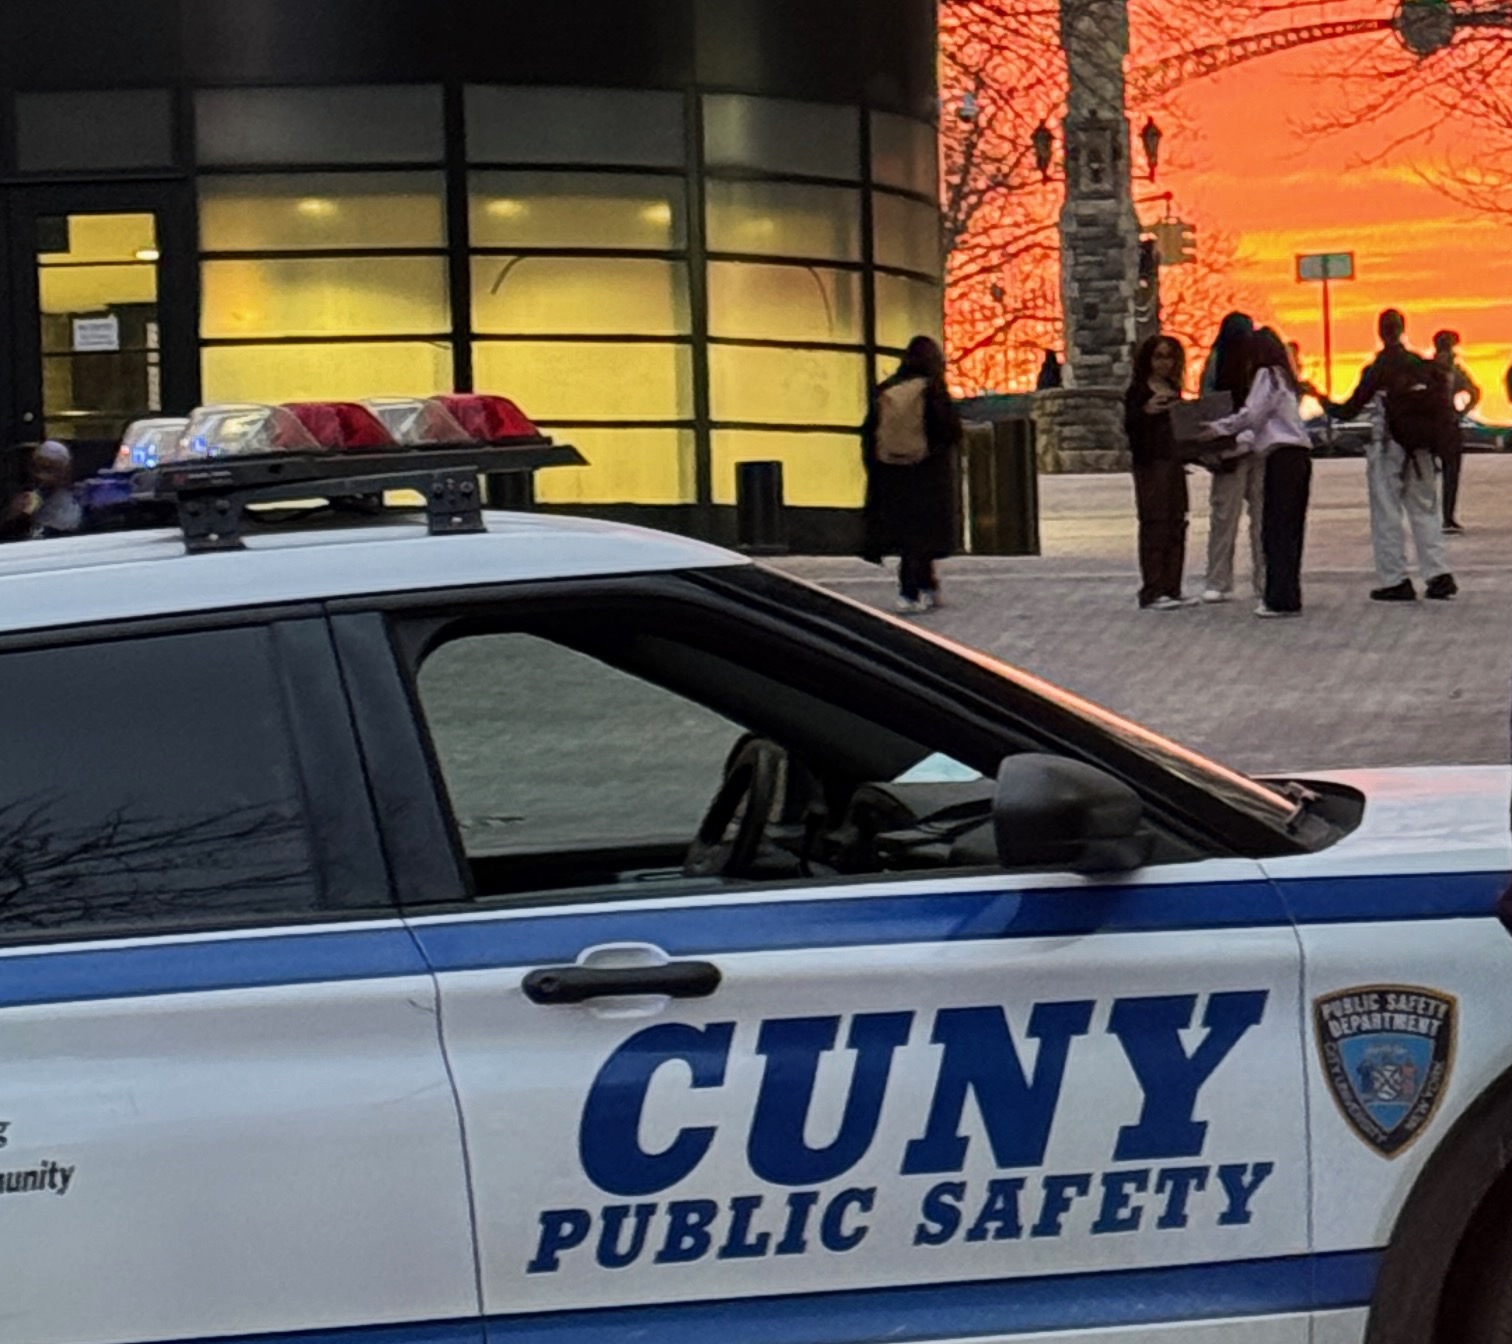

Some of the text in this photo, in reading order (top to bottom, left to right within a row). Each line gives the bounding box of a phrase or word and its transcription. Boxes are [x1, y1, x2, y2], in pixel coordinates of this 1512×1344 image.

[1321, 993, 1449, 1021] PUBLIC SAFETY
[1328, 1012, 1443, 1038] DEPARTMENT
[578, 989, 1270, 1197] CUNY
[526, 1161, 1275, 1274] PUBLIC SAFETY
